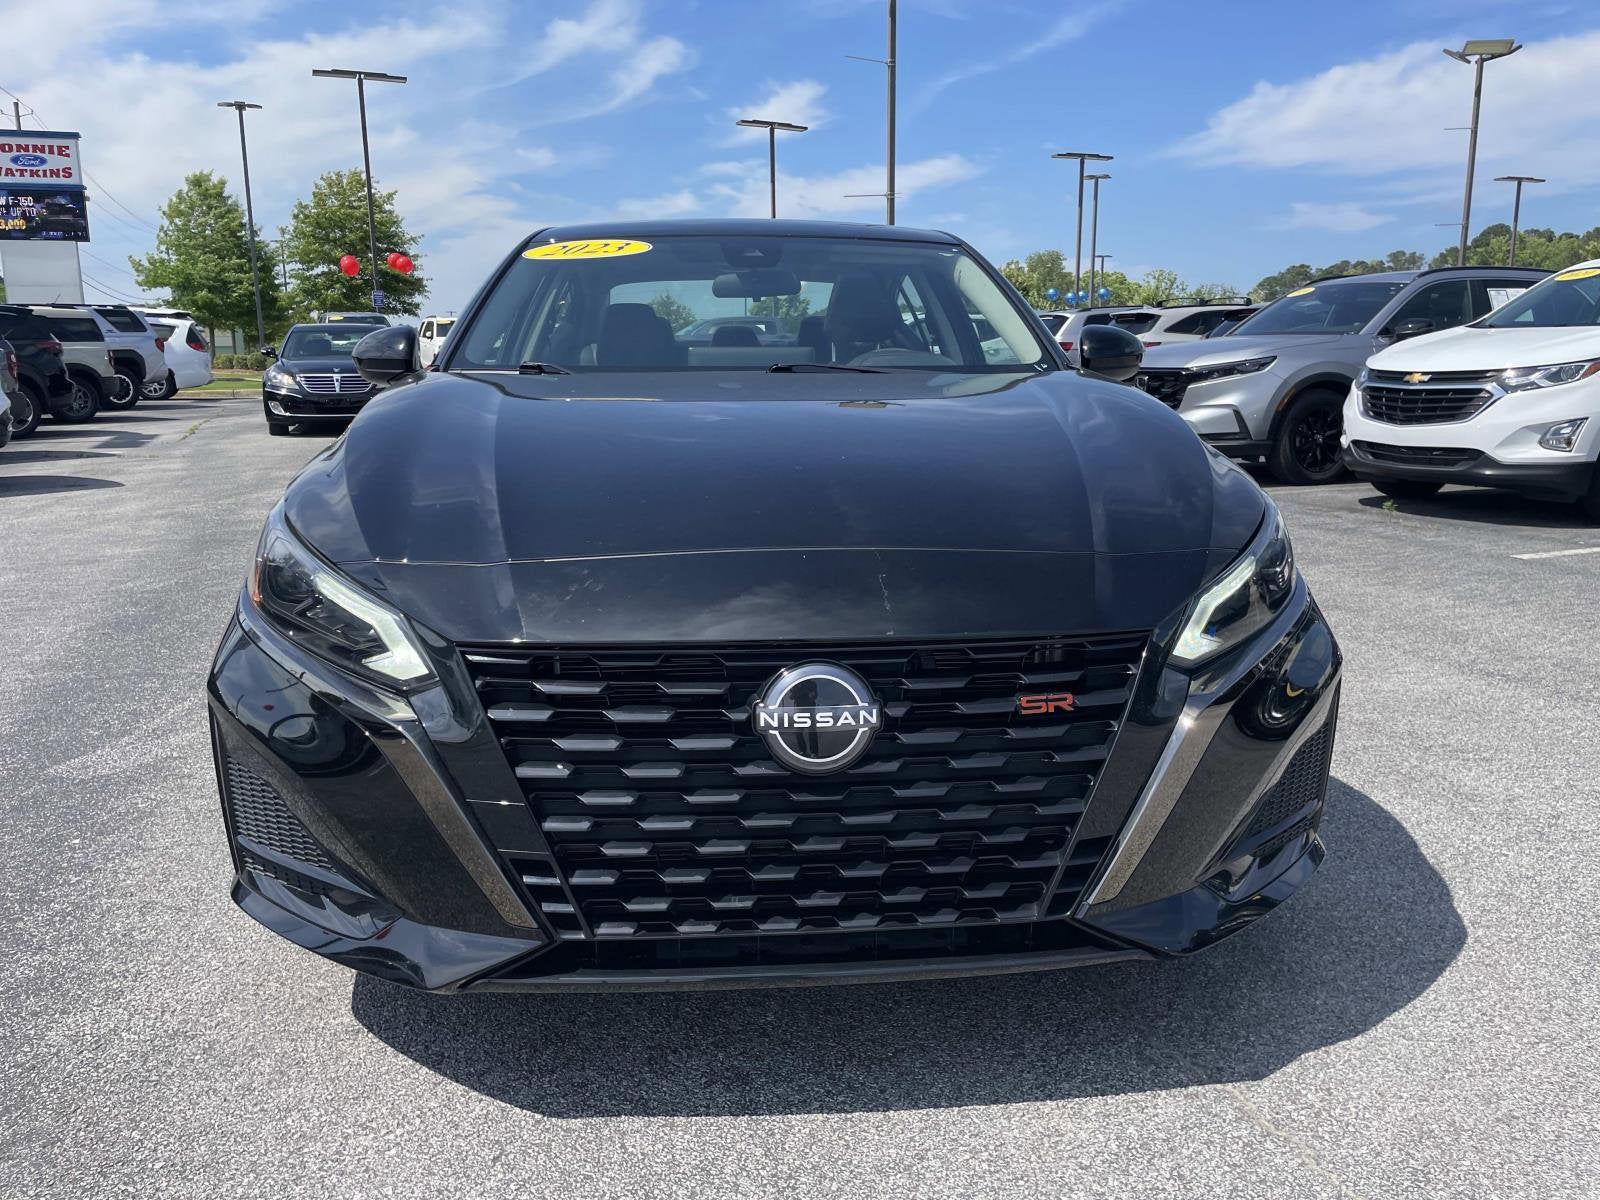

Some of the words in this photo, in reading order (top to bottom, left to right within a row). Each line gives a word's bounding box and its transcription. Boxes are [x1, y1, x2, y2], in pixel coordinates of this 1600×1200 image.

[0, 143, 71, 158] ONNIE
[18, 156, 40, 165] Ford
[540, 242, 632, 257] 2023
[1020, 693, 1074, 715] SR
[759, 708, 877, 728] NISSAN
